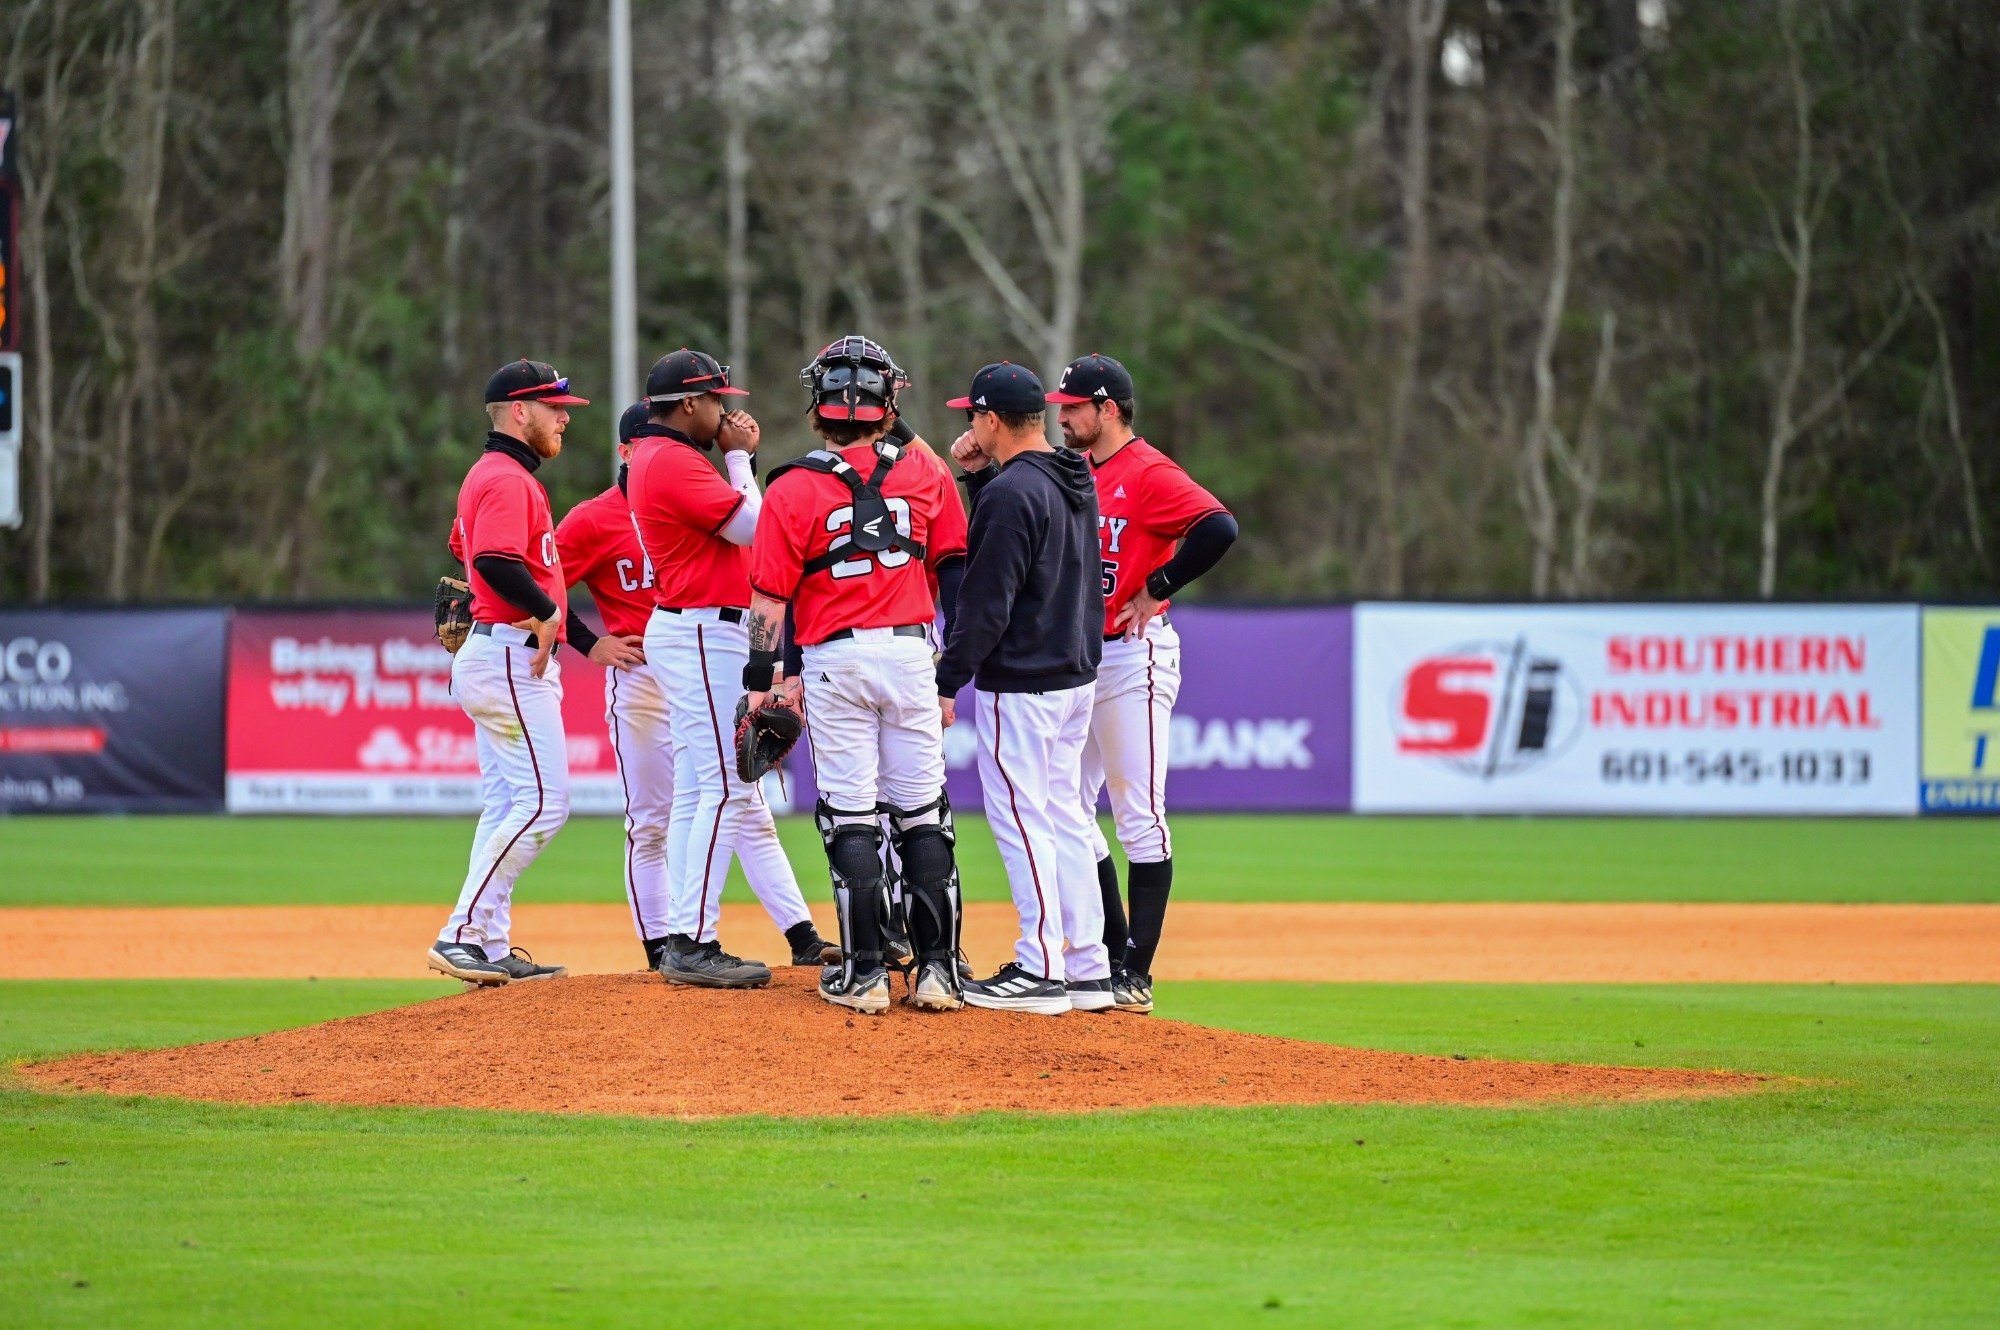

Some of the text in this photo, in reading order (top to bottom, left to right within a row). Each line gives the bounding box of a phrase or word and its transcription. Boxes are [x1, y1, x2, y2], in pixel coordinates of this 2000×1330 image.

[0, 636, 71, 684] CO
[271, 636, 376, 686] Being
[1606, 634, 1866, 674] SOUTHERN
[271, 678, 350, 717] why
[1591, 690, 1881, 730] INDUSTRIAL
[1601, 750, 1871, 785] 601-545-1033
